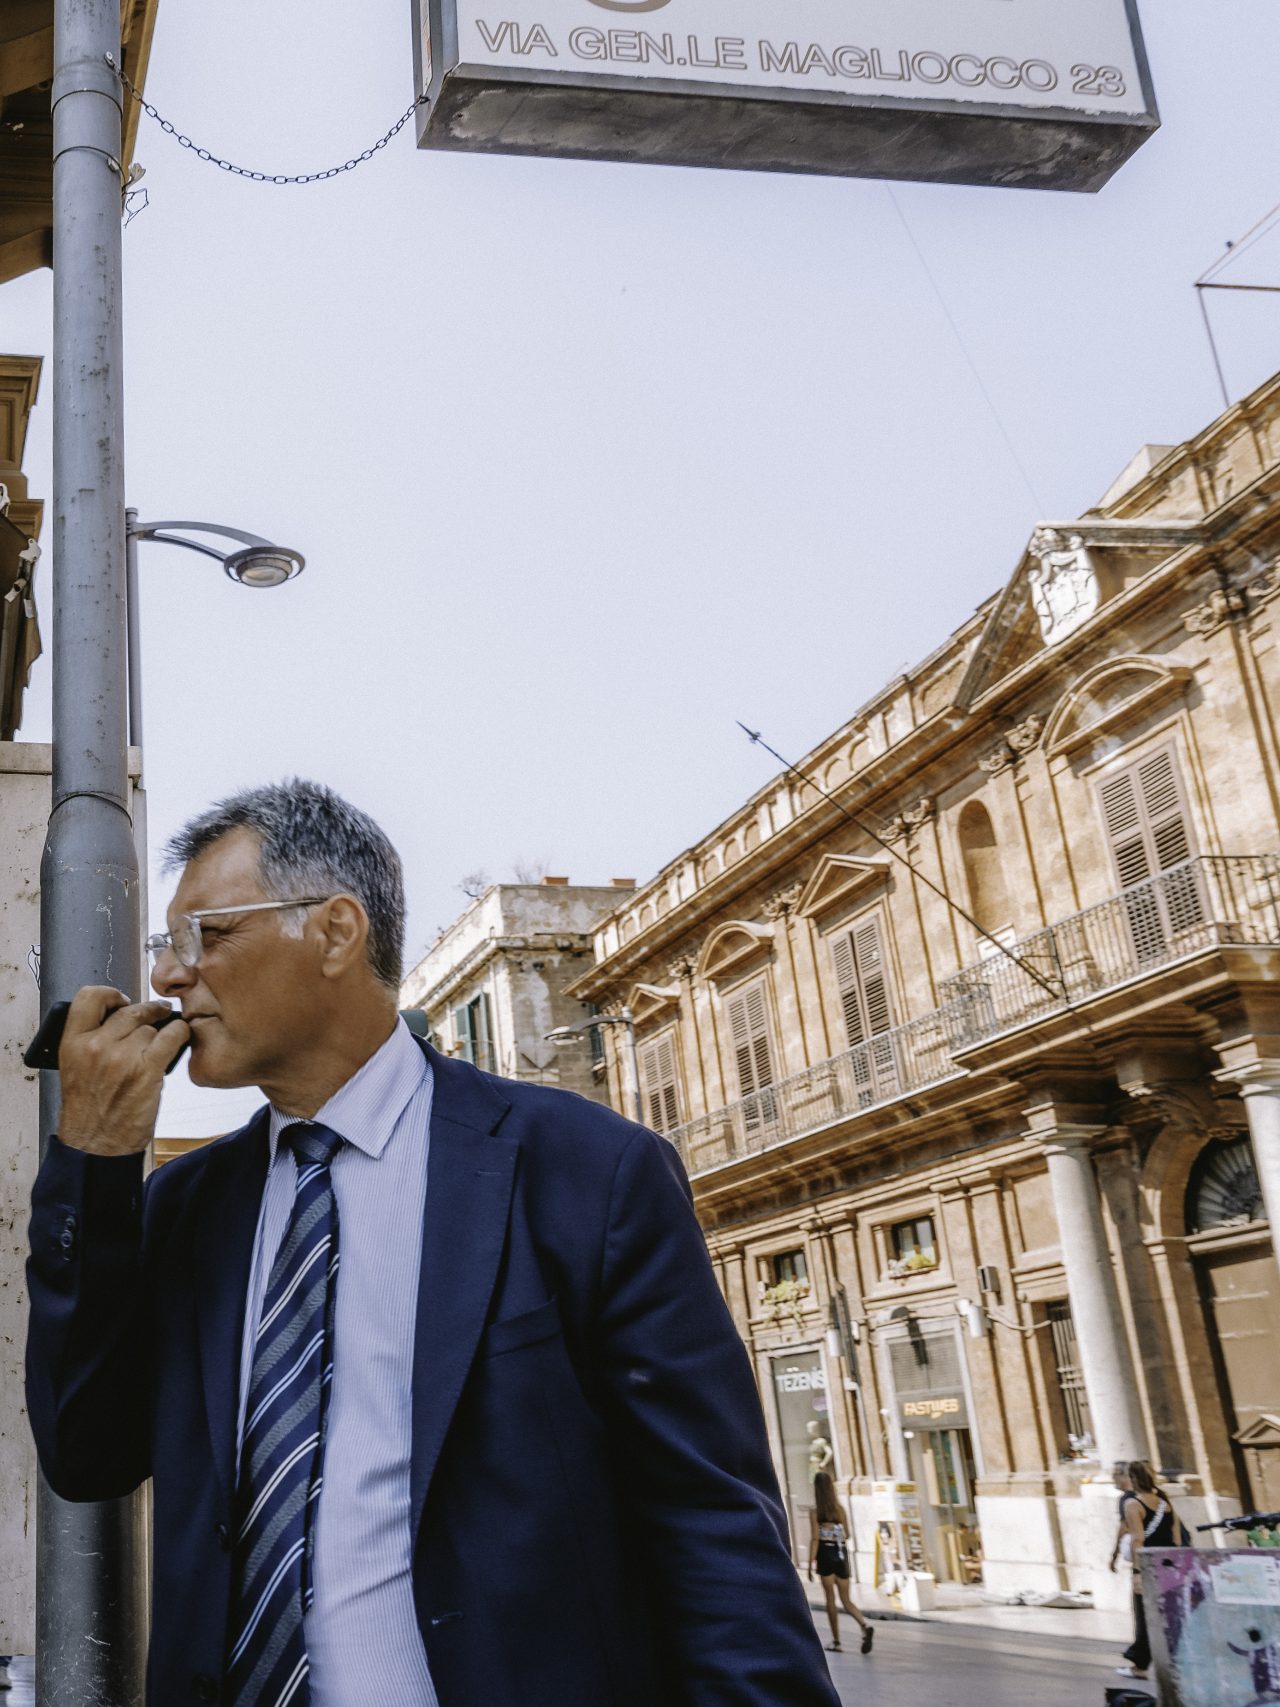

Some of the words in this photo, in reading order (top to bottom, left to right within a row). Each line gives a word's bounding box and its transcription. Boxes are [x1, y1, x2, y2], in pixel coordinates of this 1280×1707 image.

[476, 19, 558, 56] VIA
[570, 26, 748, 70] GEN.LE
[759, 40, 1058, 92] MAGLIOCCO
[1069, 64, 1126, 97] 23
